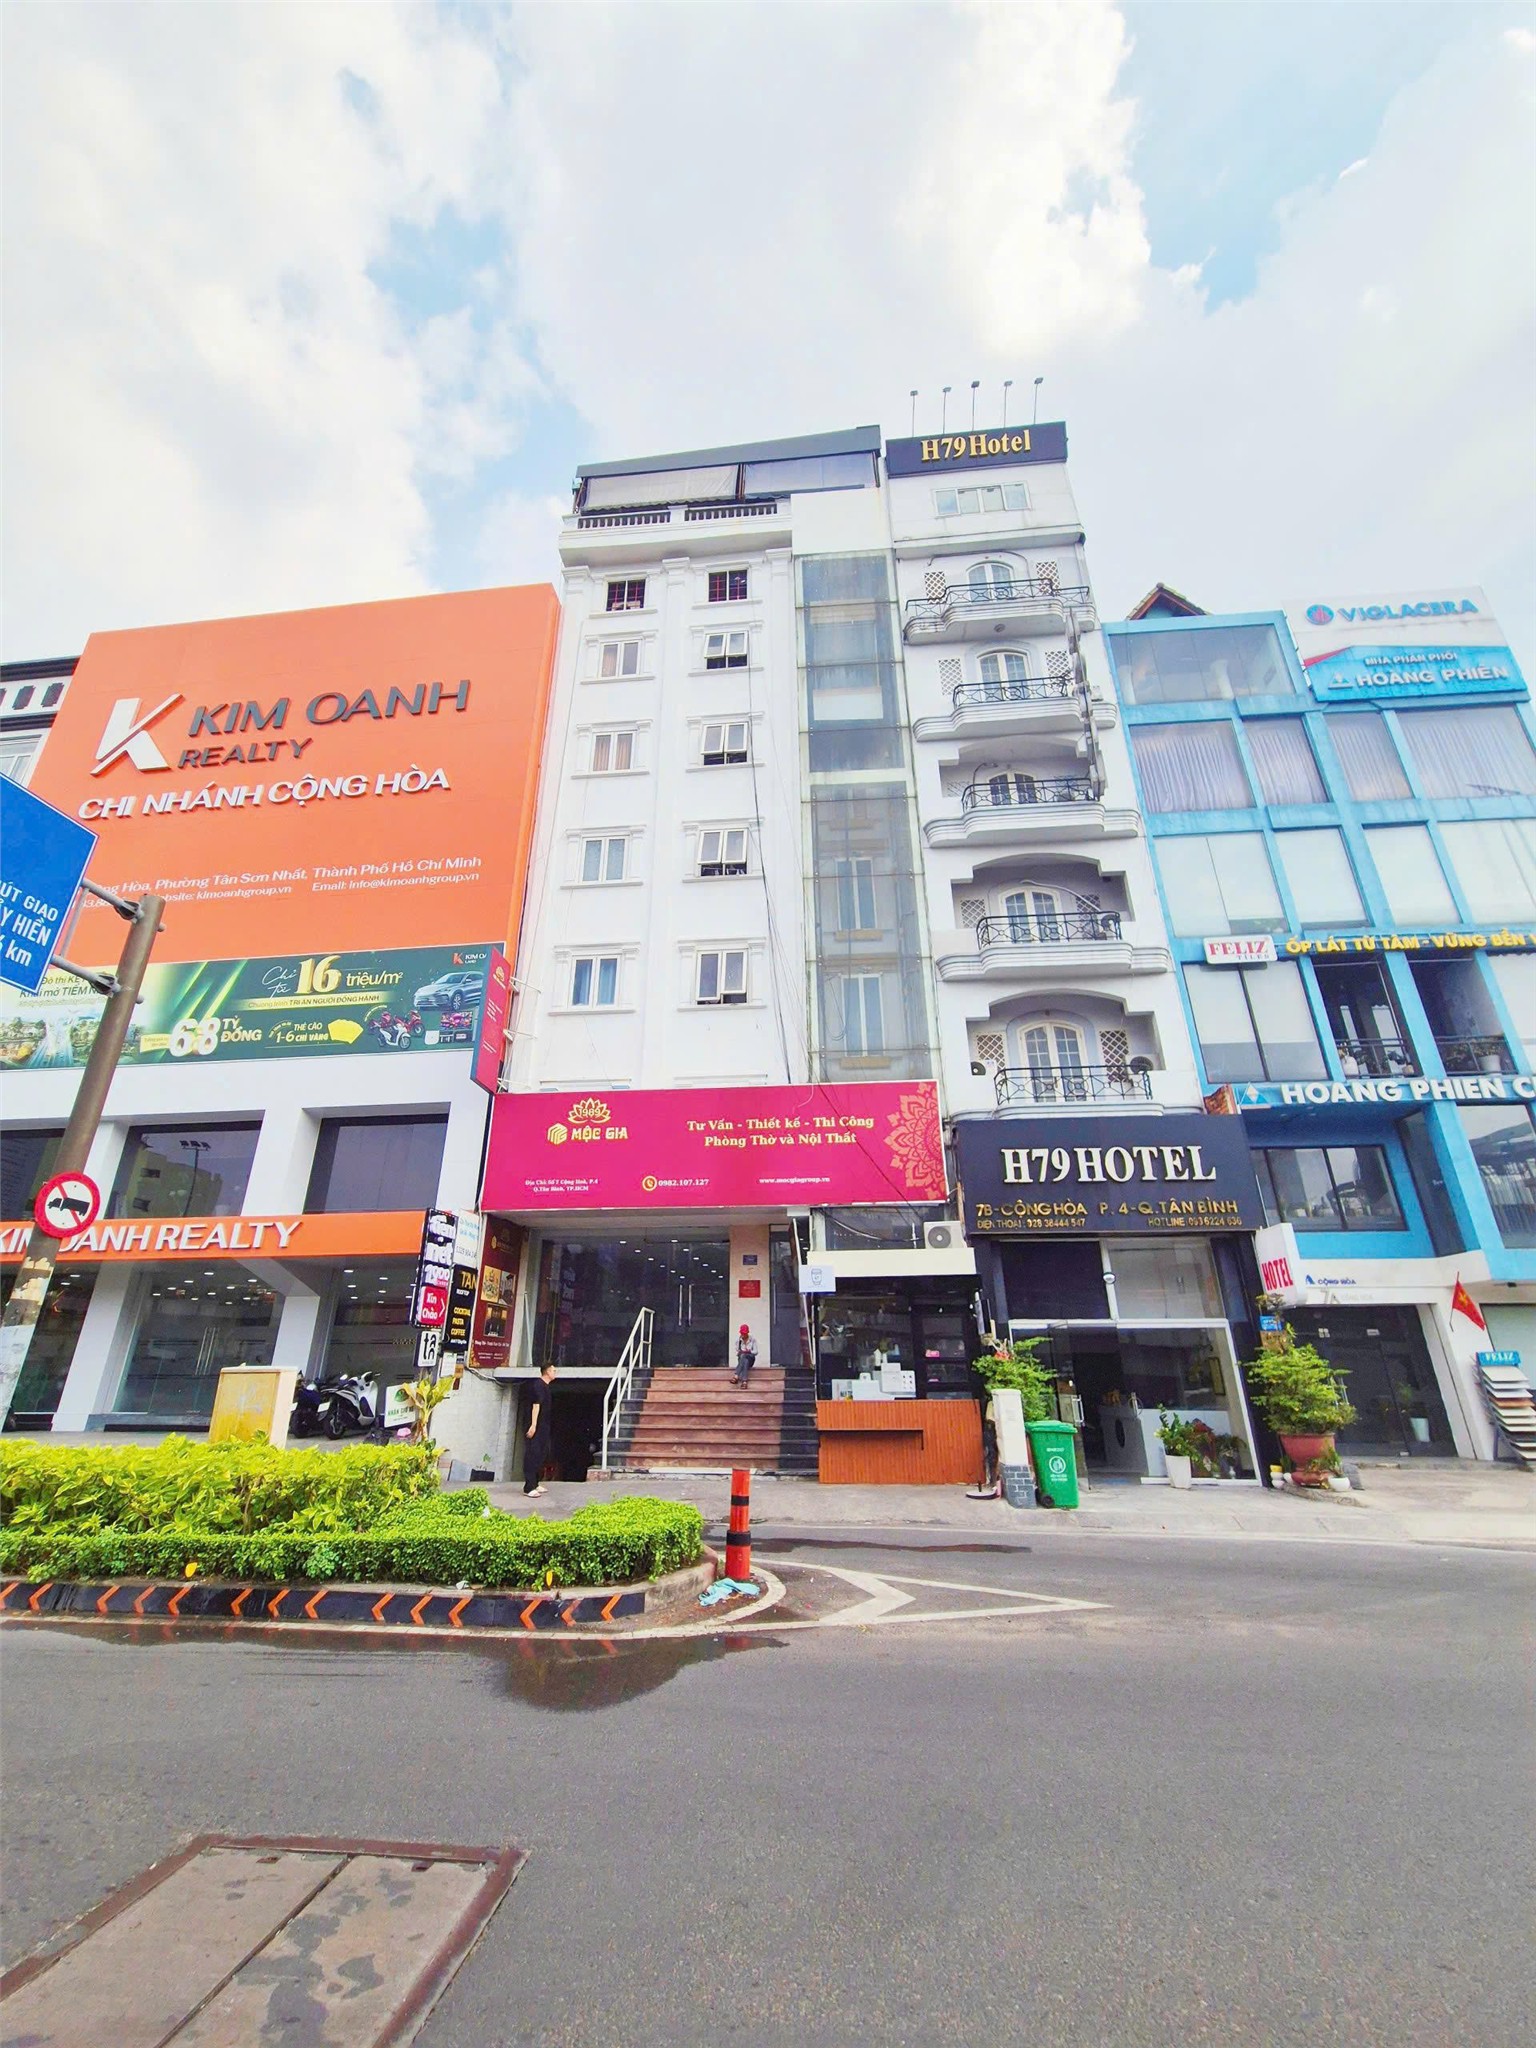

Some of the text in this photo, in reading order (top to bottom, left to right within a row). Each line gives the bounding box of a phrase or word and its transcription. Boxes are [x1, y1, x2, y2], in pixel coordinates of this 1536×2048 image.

[1338, 599, 1478, 621] VIGLACERA
[189, 679, 470, 737] KIM OANH
[177, 737, 312, 769] REALTY
[78, 764, 451, 820] CHI NHÁNH CỘNG HÒA
[23, 895, 59, 922] GIAO
[11, 912, 52, 947] HIỀN
[5, 939, 32, 967] km
[1208, 940, 1266, 956] FELIZ
[294, 954, 342, 994] 16
[1280, 1076, 1536, 1105] HOANG PHIEN C
[571, 1125, 628, 1143] MỘC GIA
[687, 1120, 706, 1131] Tư
[708, 1117, 734, 1130] Vấn
[746, 1117, 781, 1129] Thiết
[784, 1116, 800, 1128] kế
[813, 1116, 836, 1128] Thi
[839, 1115, 875, 1129] Công
[704, 1130, 857, 1148] Phòng Thờ và Nội Thất
[1001, 1145, 1217, 1184] H79 HOTEL
[1053, 1197, 1088, 1216] HÒA
[1197, 1196, 1238, 1214] BÌNH
[155, 1221, 302, 1251] REALTY
[1261, 1257, 1294, 1291] HOTEL
